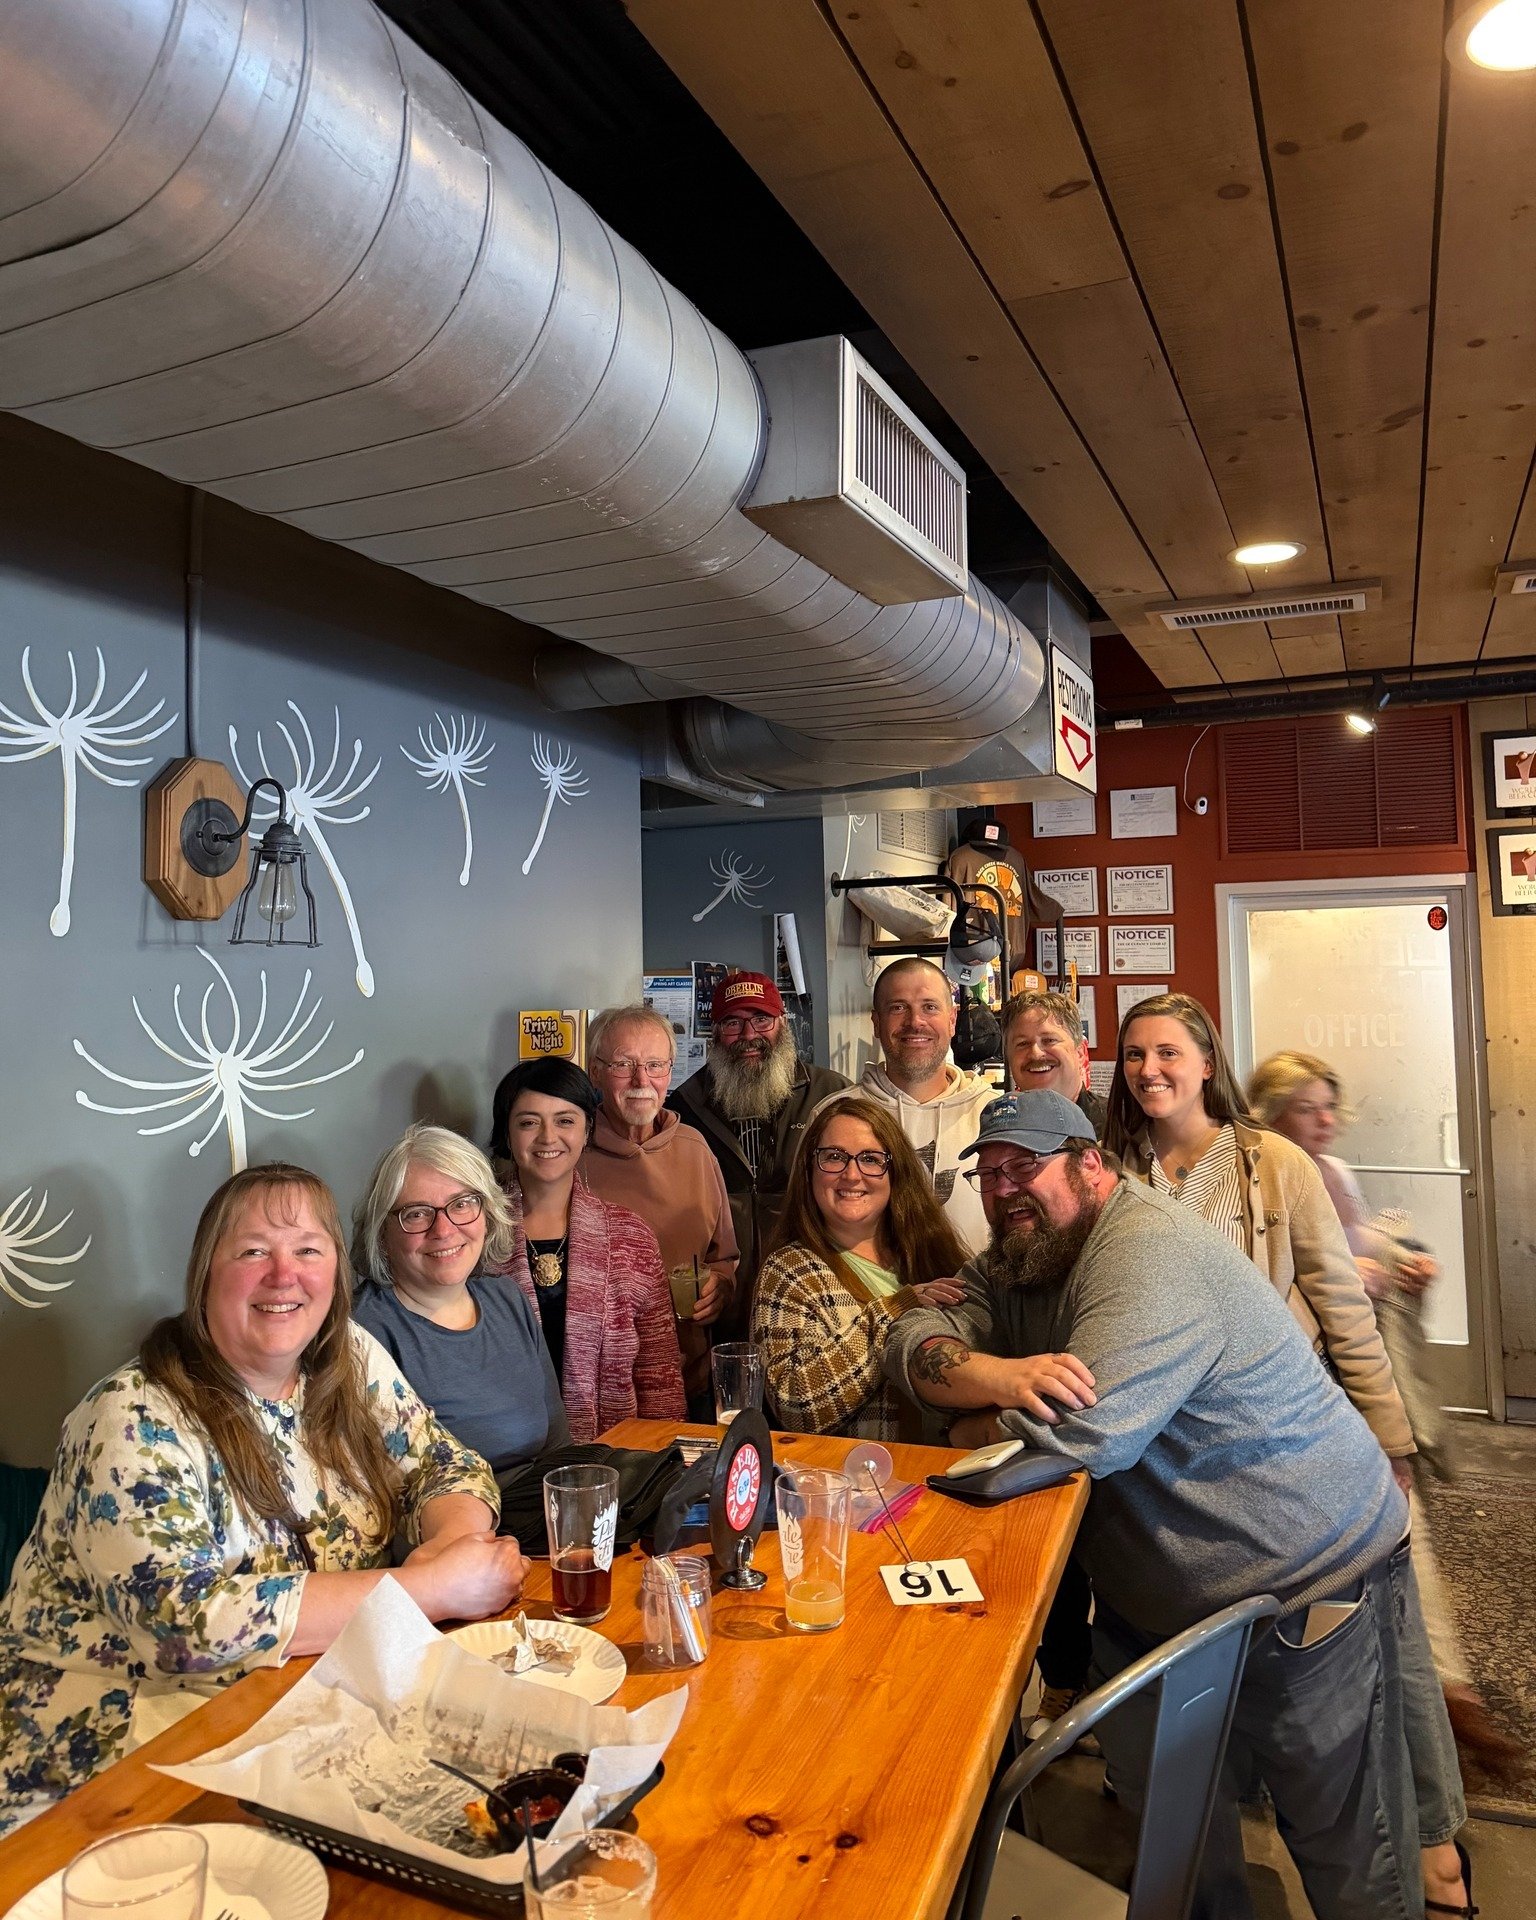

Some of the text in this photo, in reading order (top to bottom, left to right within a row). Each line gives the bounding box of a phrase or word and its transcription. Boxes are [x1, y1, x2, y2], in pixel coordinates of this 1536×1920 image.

[1057, 667, 1093, 728] RESTROOMS
[1042, 872, 1090, 883] NOTICE
[1114, 870, 1165, 880] NOTICE
[1116, 930, 1167, 940] NOTICE
[725, 982, 764, 997] OBERLIN
[523, 1016, 558, 1034] Trivia
[1304, 1014, 1405, 1048] OFFICE
[531, 1033, 563, 1052] Night
[729, 1448, 760, 1523] RESERVED
[899, 1569, 964, 1599] 16
